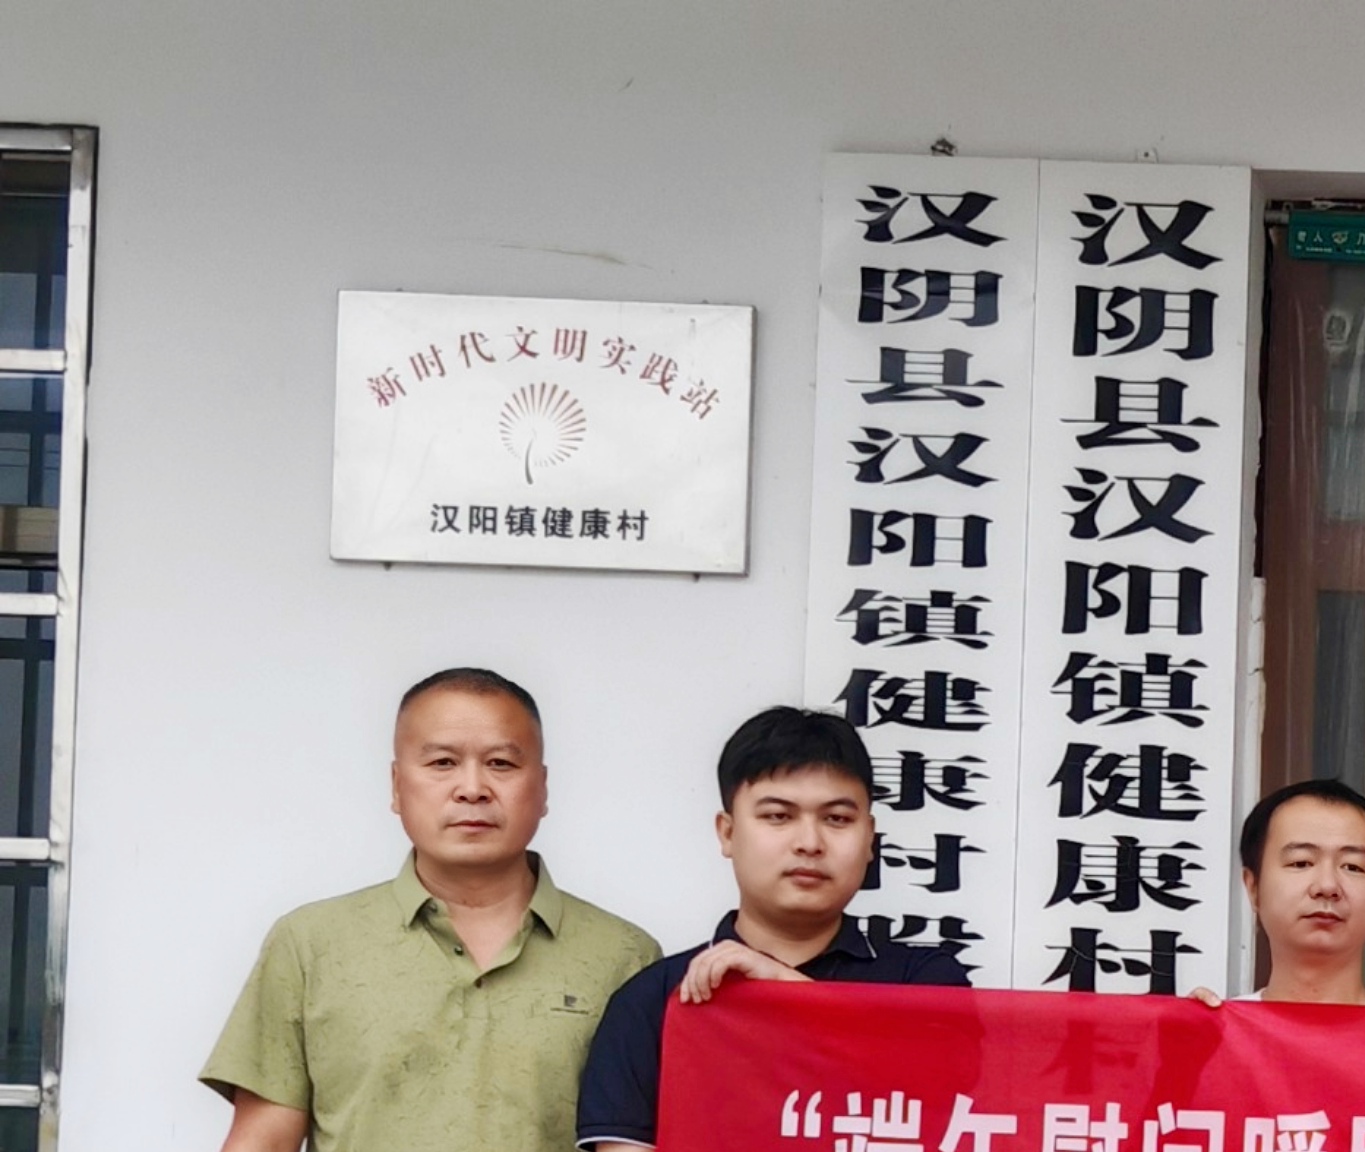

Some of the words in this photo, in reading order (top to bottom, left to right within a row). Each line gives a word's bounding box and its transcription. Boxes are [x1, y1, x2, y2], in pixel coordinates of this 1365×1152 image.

[366, 325, 721, 420] 新时代文明实践站
[430, 504, 650, 542] 汉阳镇健康村
[1041, 193, 1225, 997] 汉阴县汉阳镇健康村
